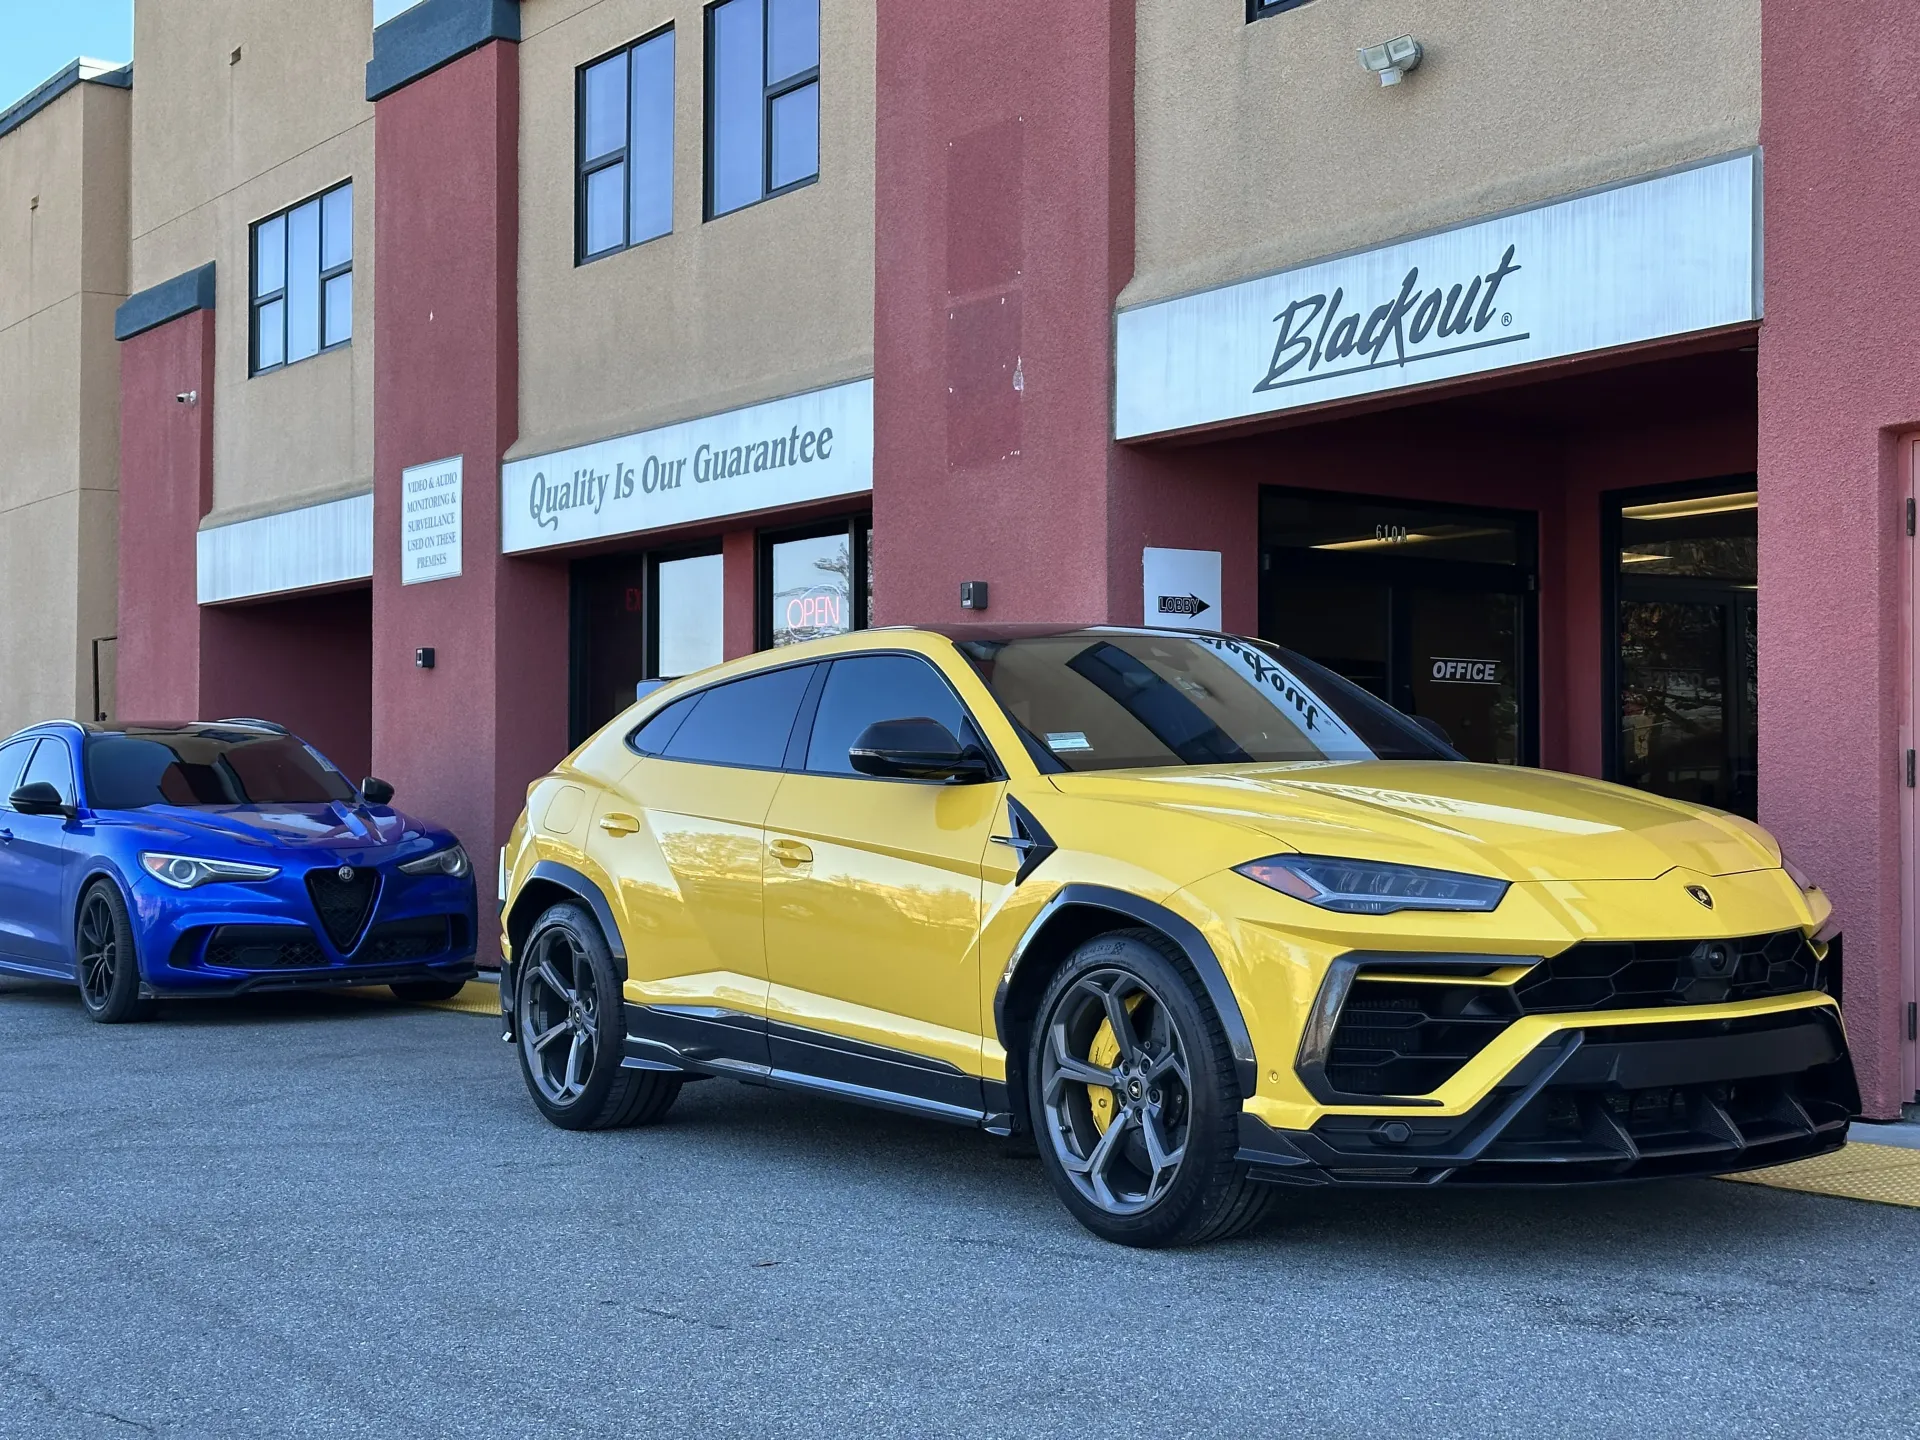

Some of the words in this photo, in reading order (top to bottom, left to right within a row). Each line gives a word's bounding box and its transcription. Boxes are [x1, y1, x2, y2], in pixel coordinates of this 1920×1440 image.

[1253, 244, 1521, 393] Blackout
[407, 478, 428, 493] VIDEO
[435, 471, 457, 487] AUDIO
[529, 469, 611, 531] Quality
[614, 462, 635, 500] Is
[641, 455, 687, 494] Our
[693, 425, 834, 484] Guarantee
[407, 492, 450, 513] MONITORING
[407, 512, 455, 533] SURVEILLANCE
[407, 538, 424, 552] USED
[424, 536, 435, 549] ON
[435, 532, 456, 546] THESE
[416, 552, 447, 569] PREMISES
[787, 595, 839, 628] OPEN
[1159, 596, 1199, 613] LOBBY
[1432, 661, 1496, 680] OFFICE
